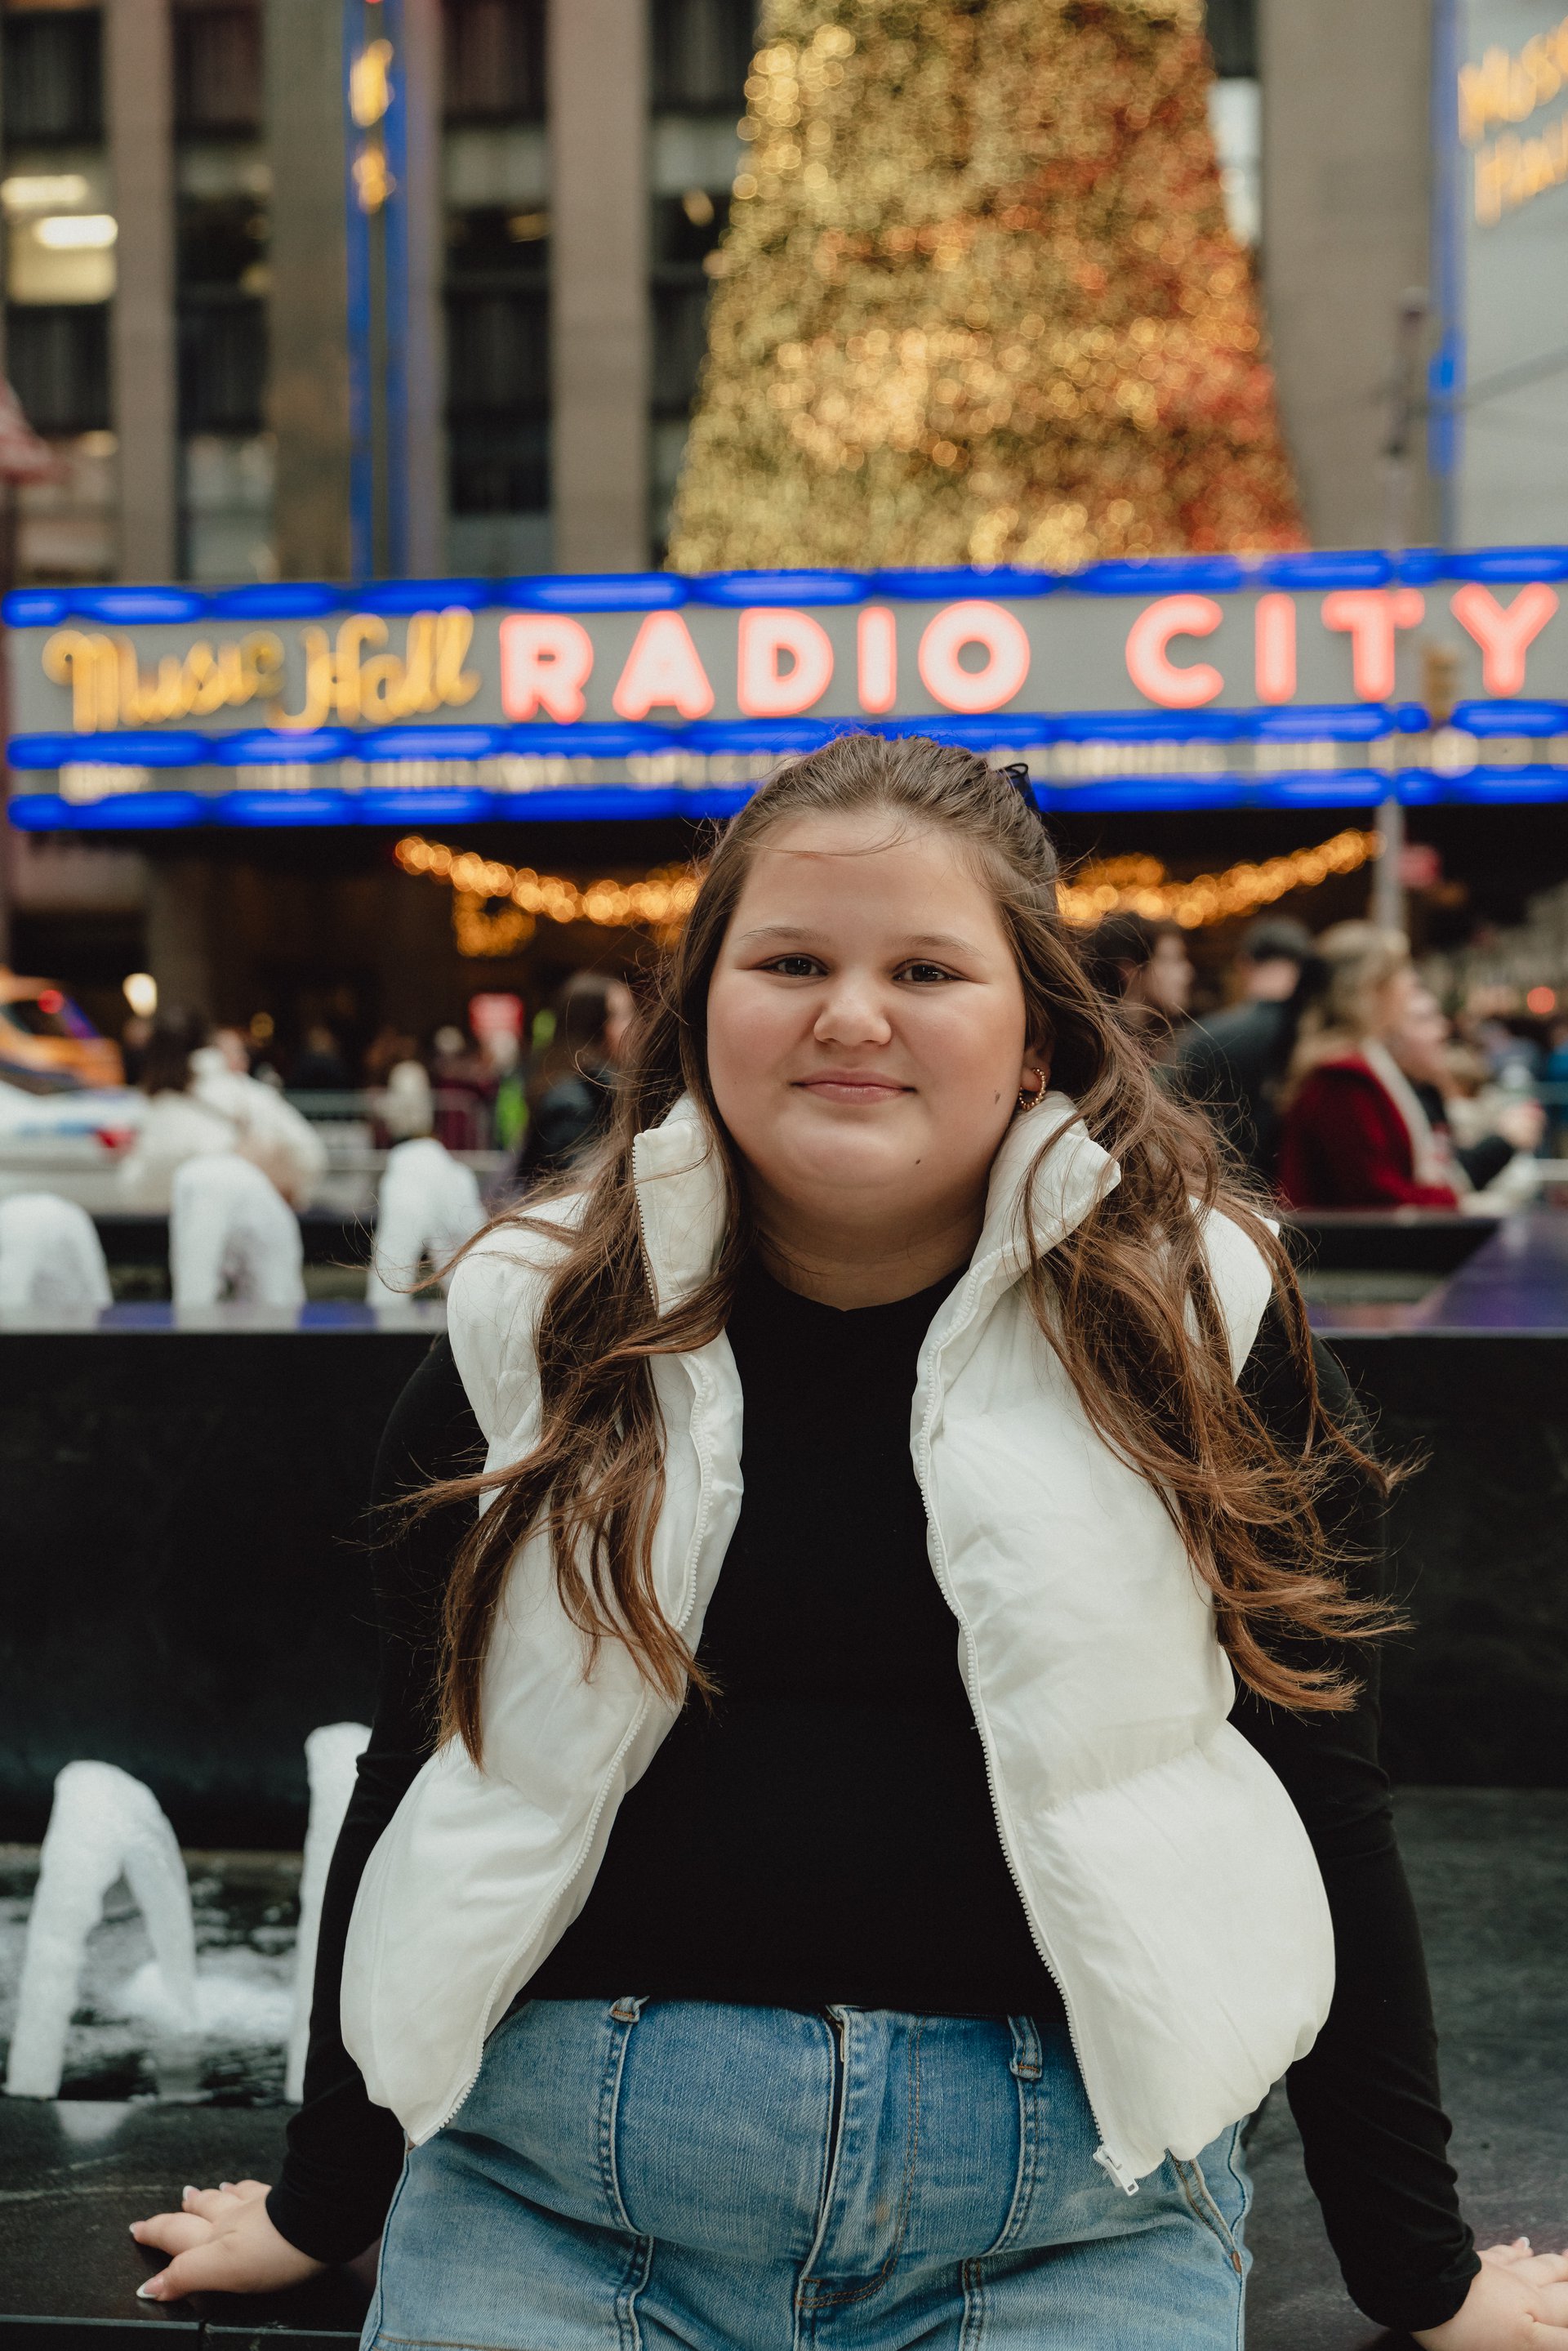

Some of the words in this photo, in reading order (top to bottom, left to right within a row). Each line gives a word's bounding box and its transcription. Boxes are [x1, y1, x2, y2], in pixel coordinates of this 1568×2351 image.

[42, 630, 284, 734] Music
[265, 606, 480, 734] Hall
[499, 600, 1031, 724] RADIO
[1125, 582, 1559, 708] CITY
